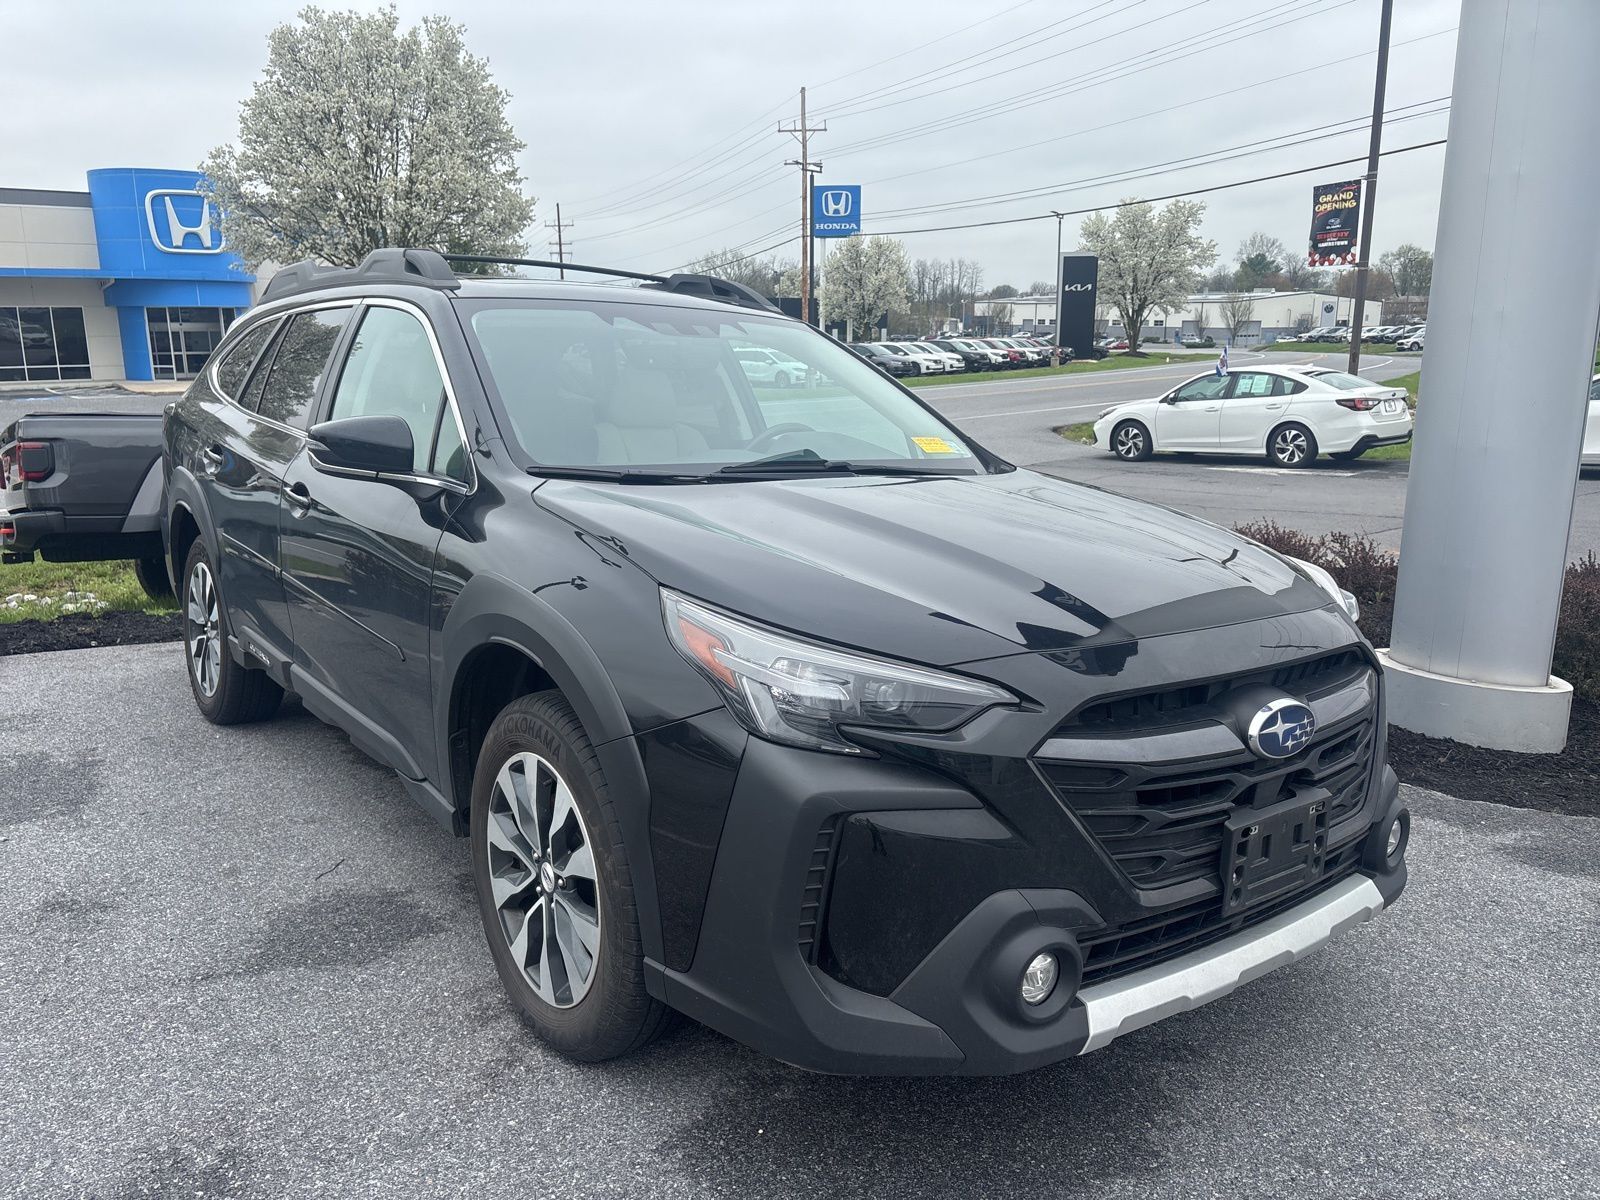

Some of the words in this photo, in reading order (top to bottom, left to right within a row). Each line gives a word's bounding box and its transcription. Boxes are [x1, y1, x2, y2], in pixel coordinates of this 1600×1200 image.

[1319, 191, 1353, 202] GRAND
[1315, 199, 1357, 212] OPENING
[1064, 283, 1092, 291] KIA
